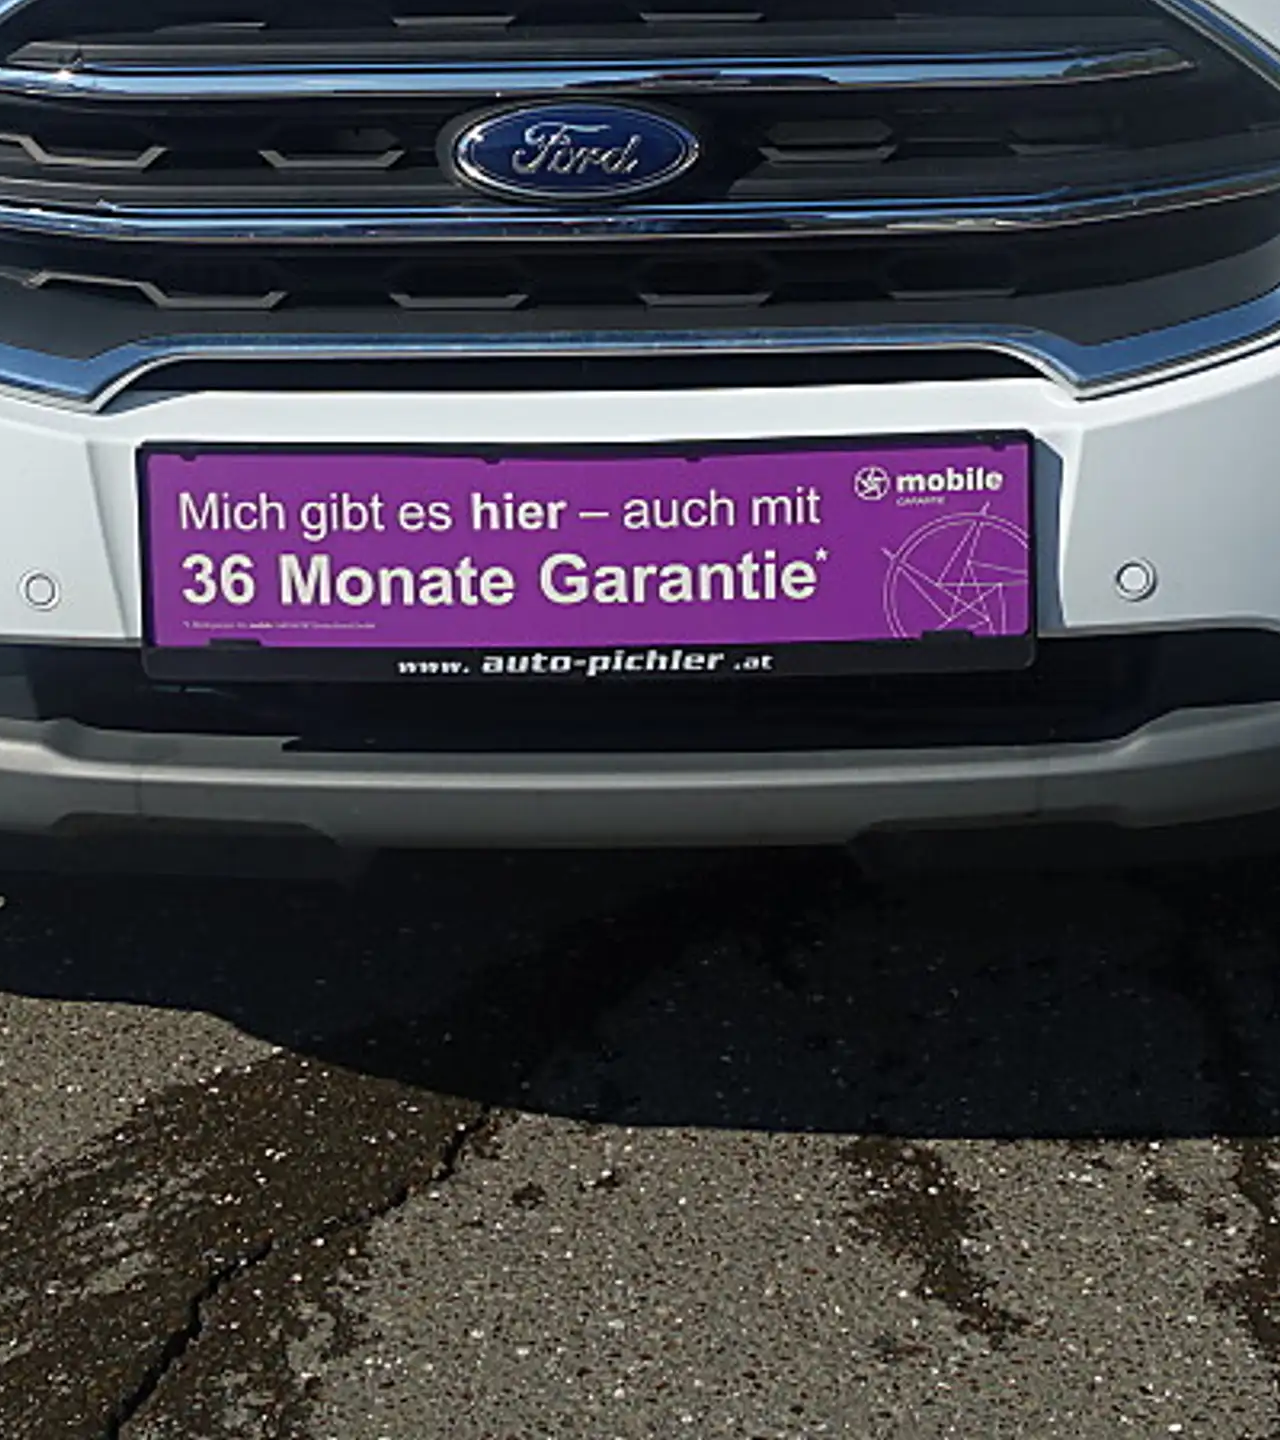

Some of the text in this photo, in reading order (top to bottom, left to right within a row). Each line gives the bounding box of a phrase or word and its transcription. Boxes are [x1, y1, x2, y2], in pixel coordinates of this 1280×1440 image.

[512, 121, 642, 174] Ford
[896, 466, 1003, 493] mobile
[178, 491, 286, 531] Mich
[300, 491, 386, 542] gibt
[398, 499, 453, 531] es
[471, 491, 568, 530] hier
[623, 488, 735, 529] auch
[751, 486, 821, 526] mit
[181, 553, 256, 605] 36
[278, 553, 515, 606] Monate
[397, 649, 773, 677] www. auto-pichler .at
